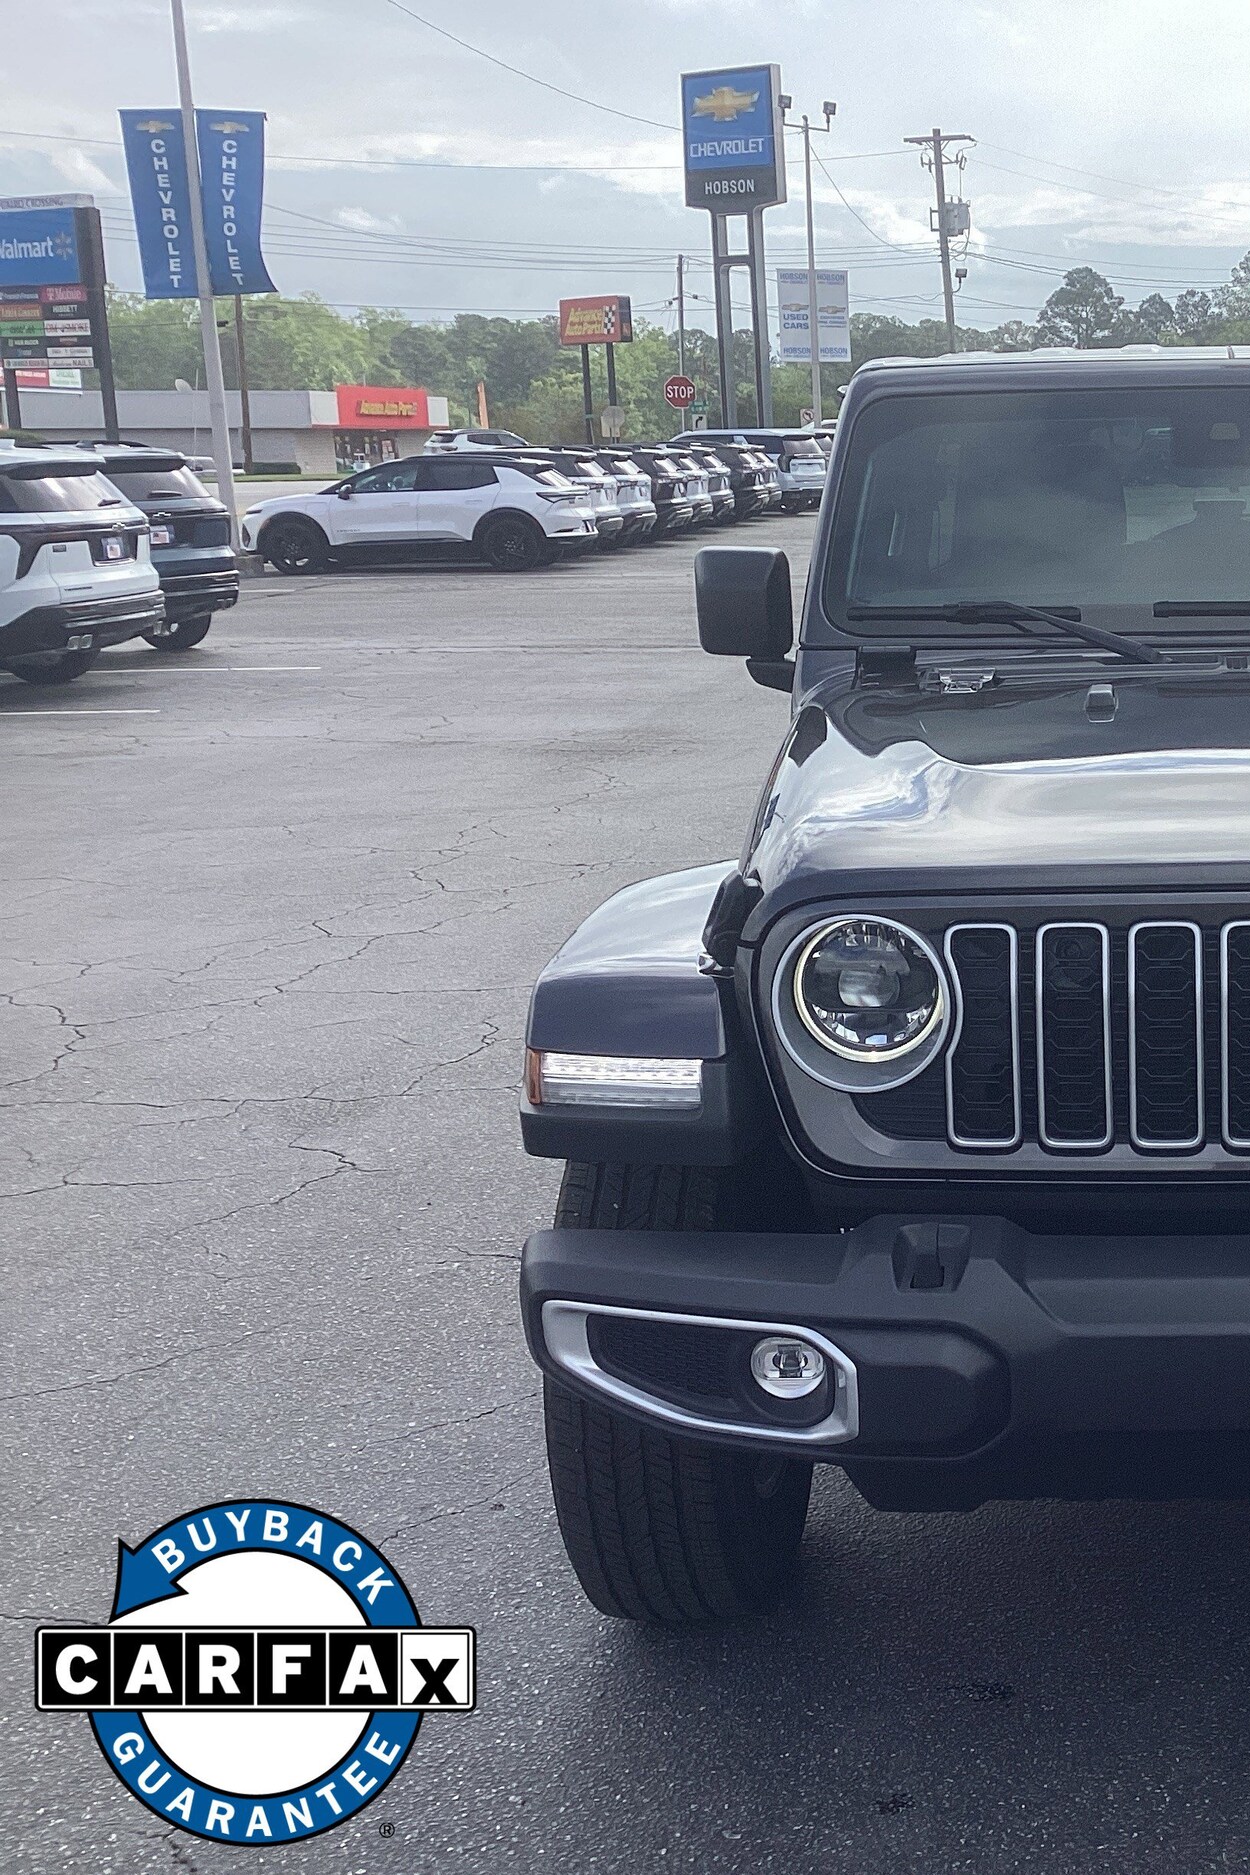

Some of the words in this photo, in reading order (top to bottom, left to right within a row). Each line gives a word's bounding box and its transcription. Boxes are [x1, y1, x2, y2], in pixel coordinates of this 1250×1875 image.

[689, 138, 765, 158] CHEVROLET
[704, 179, 755, 195] HOBSON
[150, 139, 181, 288] CHEVROLET
[221, 140, 243, 286] CHEVROLET
[780, 272, 808, 280] HOBSON
[817, 273, 845, 282] HOBSON
[783, 313, 809, 321] USED
[783, 322, 809, 330] CARS
[783, 346, 811, 355] HOBSON
[820, 347, 848, 355] HOBSON
[666, 385, 694, 399] STOP
